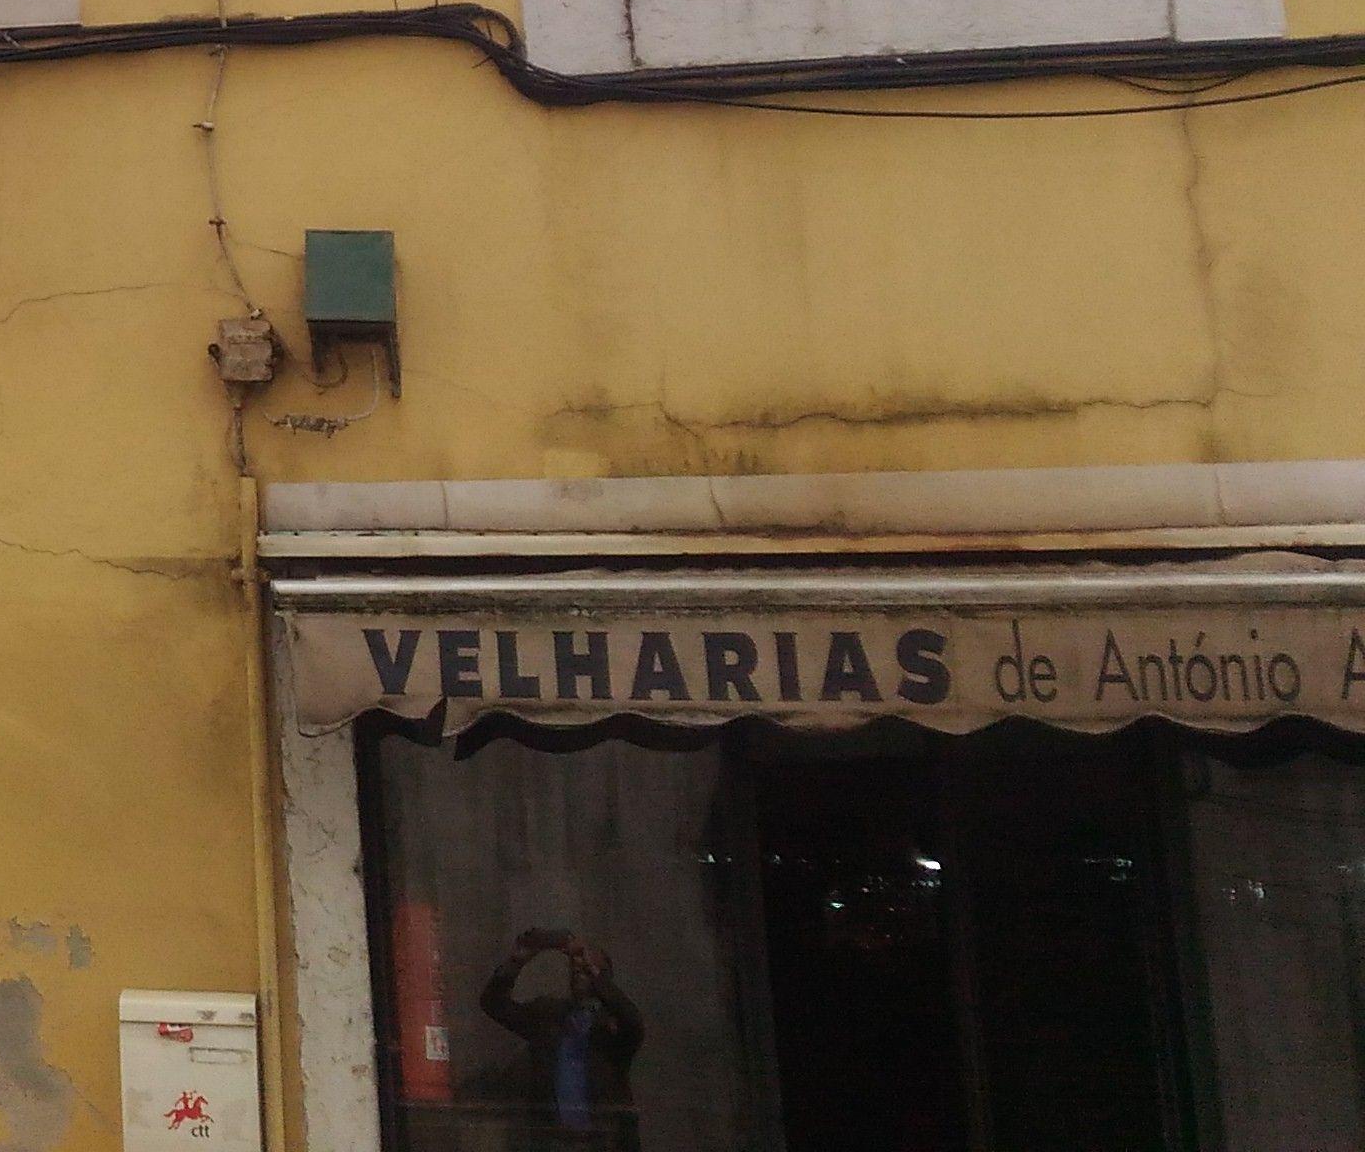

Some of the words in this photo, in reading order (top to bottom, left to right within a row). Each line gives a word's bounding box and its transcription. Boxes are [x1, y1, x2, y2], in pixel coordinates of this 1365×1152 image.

[361, 628, 952, 705] VELHARIAS
[994, 618, 1058, 703] de
[1095, 628, 1302, 703] António
[190, 1124, 211, 1138] ctt
